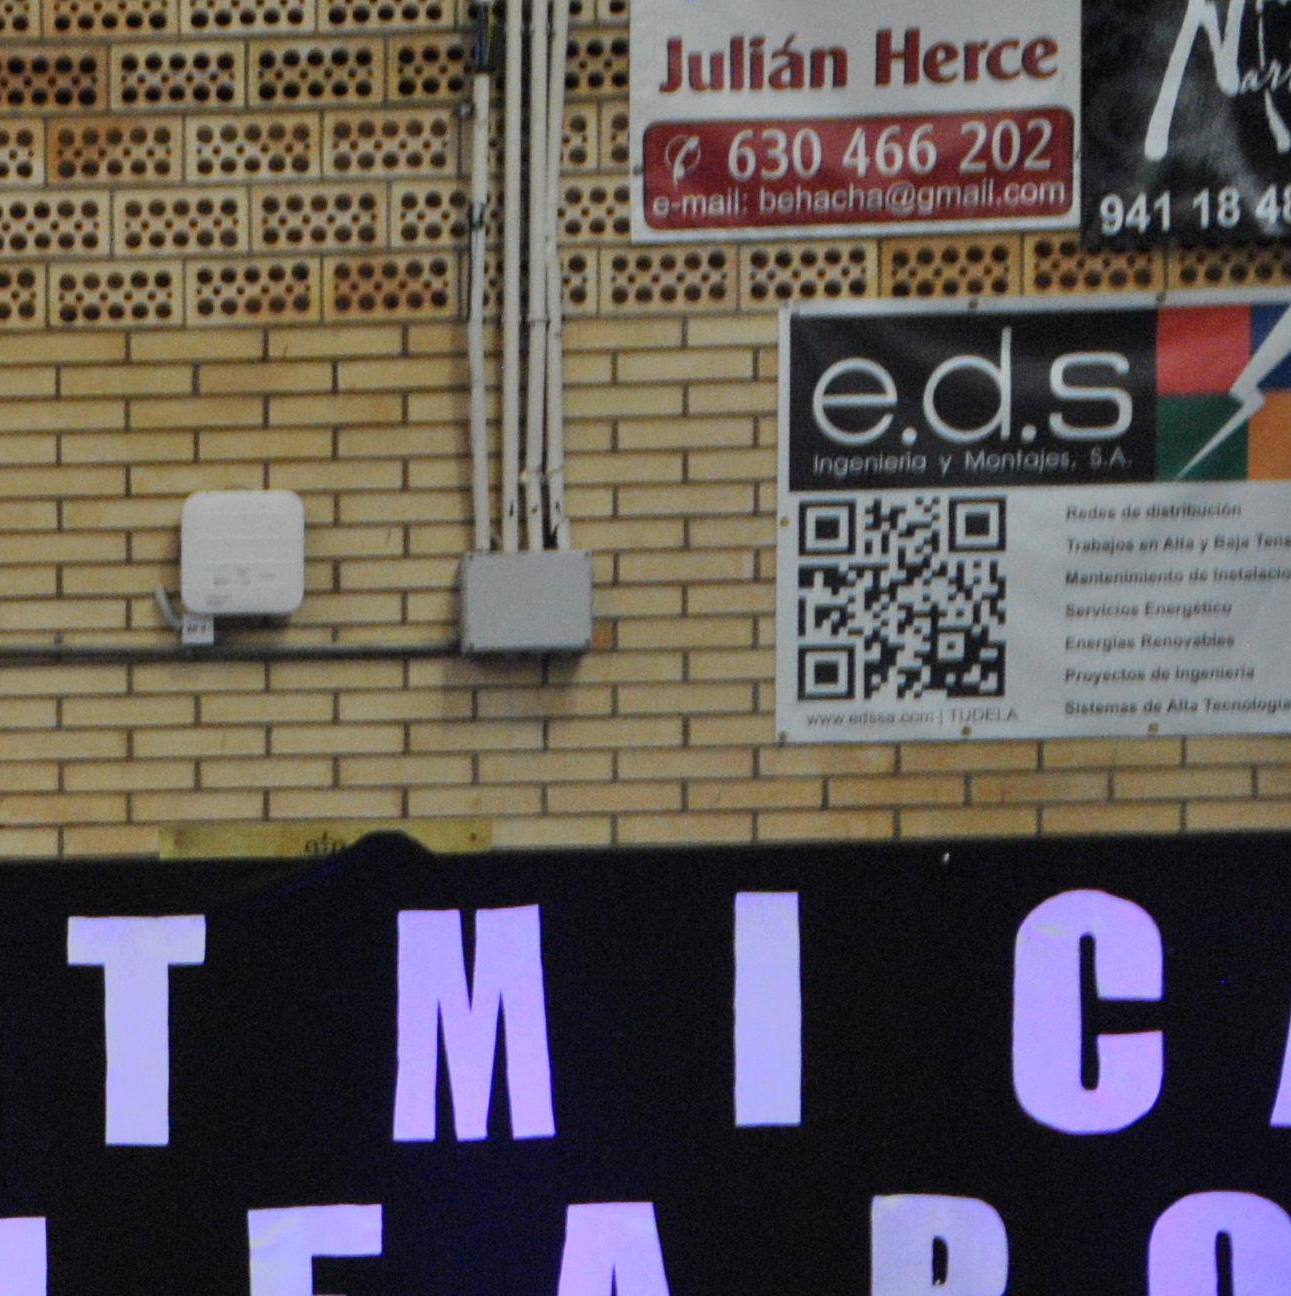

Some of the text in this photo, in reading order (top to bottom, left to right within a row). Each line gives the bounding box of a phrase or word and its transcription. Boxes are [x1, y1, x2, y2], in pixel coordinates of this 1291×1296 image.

[658, 27, 1059, 93] Julián Herce
[728, 117, 1053, 181] 630 466 202
[653, 178, 1066, 218] e-mail: behacha@gmail.com
[1100, 190, 1170, 236] 941
[1193, 186, 1241, 229] 18
[812, 325, 1133, 446] e.d.s
[939, 454, 953, 475] y
[1066, 505, 1116, 519] Redes
[1122, 504, 1141, 518] de
[1067, 536, 1133, 555] Trabajos
[1139, 538, 1159, 551] en
[1163, 535, 1194, 550] Alta
[1200, 537, 1209, 555] y
[1214, 535, 1249, 552] Baja
[1066, 569, 1184, 585] Mantenimiento
[1189, 568, 1208, 582] de
[1066, 602, 1139, 618] Servicios
[1141, 632, 1235, 648] Renovables
[1065, 667, 1146, 686] Proyectos
[1151, 667, 1169, 681] de
[951, 707, 1019, 722] TUDELA
[1065, 700, 1138, 715] Sistemas
[1143, 699, 1162, 713] de
[1167, 698, 1198, 713] Alta
